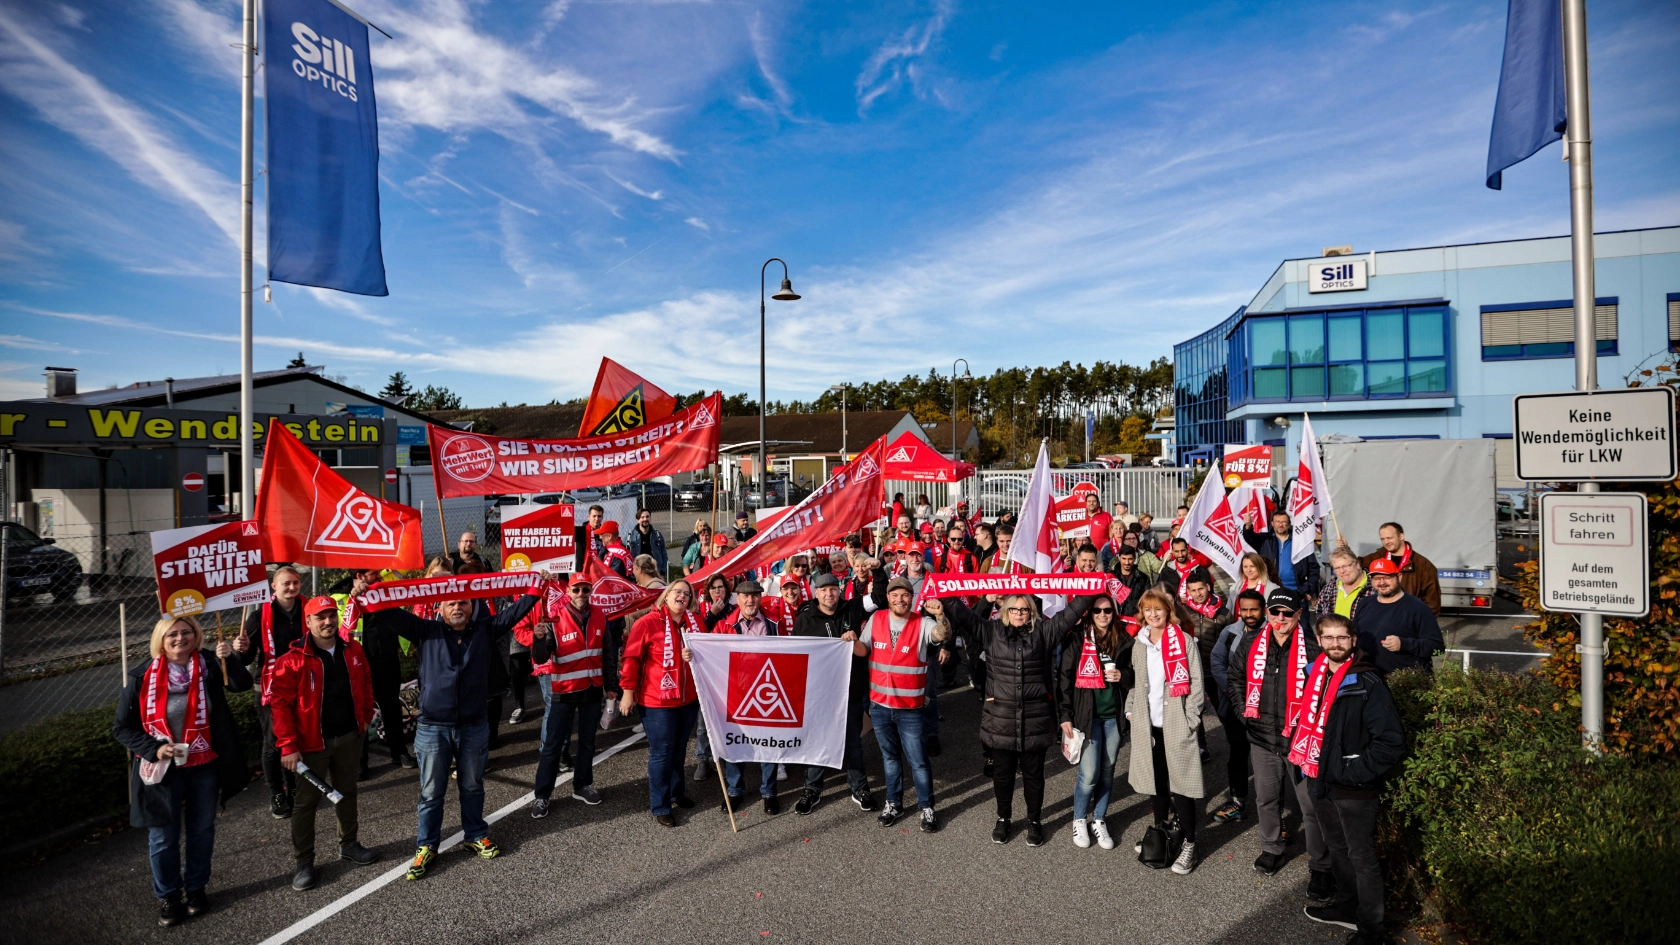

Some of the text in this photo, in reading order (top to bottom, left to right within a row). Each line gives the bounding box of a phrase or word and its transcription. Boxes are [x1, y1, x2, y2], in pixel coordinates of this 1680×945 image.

[291, 22, 356, 85] Sill
[292, 59, 358, 102] OPTICS
[1321, 264, 1353, 281] Sill
[1322, 280, 1354, 289] OPTICS
[1569, 409, 1612, 423] Keine
[87, 409, 379, 442] Wendestein
[1521, 427, 1666, 446] Wendemöglichkeit
[497, 440, 529, 456] SIE
[1561, 448, 1623, 463] für LKW
[442, 449, 494, 467] MehrWert
[500, 444, 660, 477] WIR SIND BEREIT!
[456, 465, 470, 474] mit
[1225, 461, 1245, 472] FÜR
[1569, 512, 1615, 523] Schritt
[504, 527, 561, 536] WIR HABEN ES
[1570, 528, 1615, 540] fahren
[188, 539, 238, 558] DAFÜR
[505, 535, 573, 549] VERDIENT!
[1195, 530, 1236, 565] Schwabach
[161, 549, 262, 579] STREITEN
[1572, 563, 1614, 574] Auf dem
[204, 567, 249, 588] WIR
[937, 575, 1102, 593] SOLIDARITÄT GEWINNT!
[1568, 579, 1618, 589] gesamten
[357, 574, 545, 607] SOLIDARITÄT GEWINNT!
[1552, 590, 1635, 605] Betriebsgelände
[562, 631, 578, 642] GEBT
[725, 731, 801, 748] Schwabach
